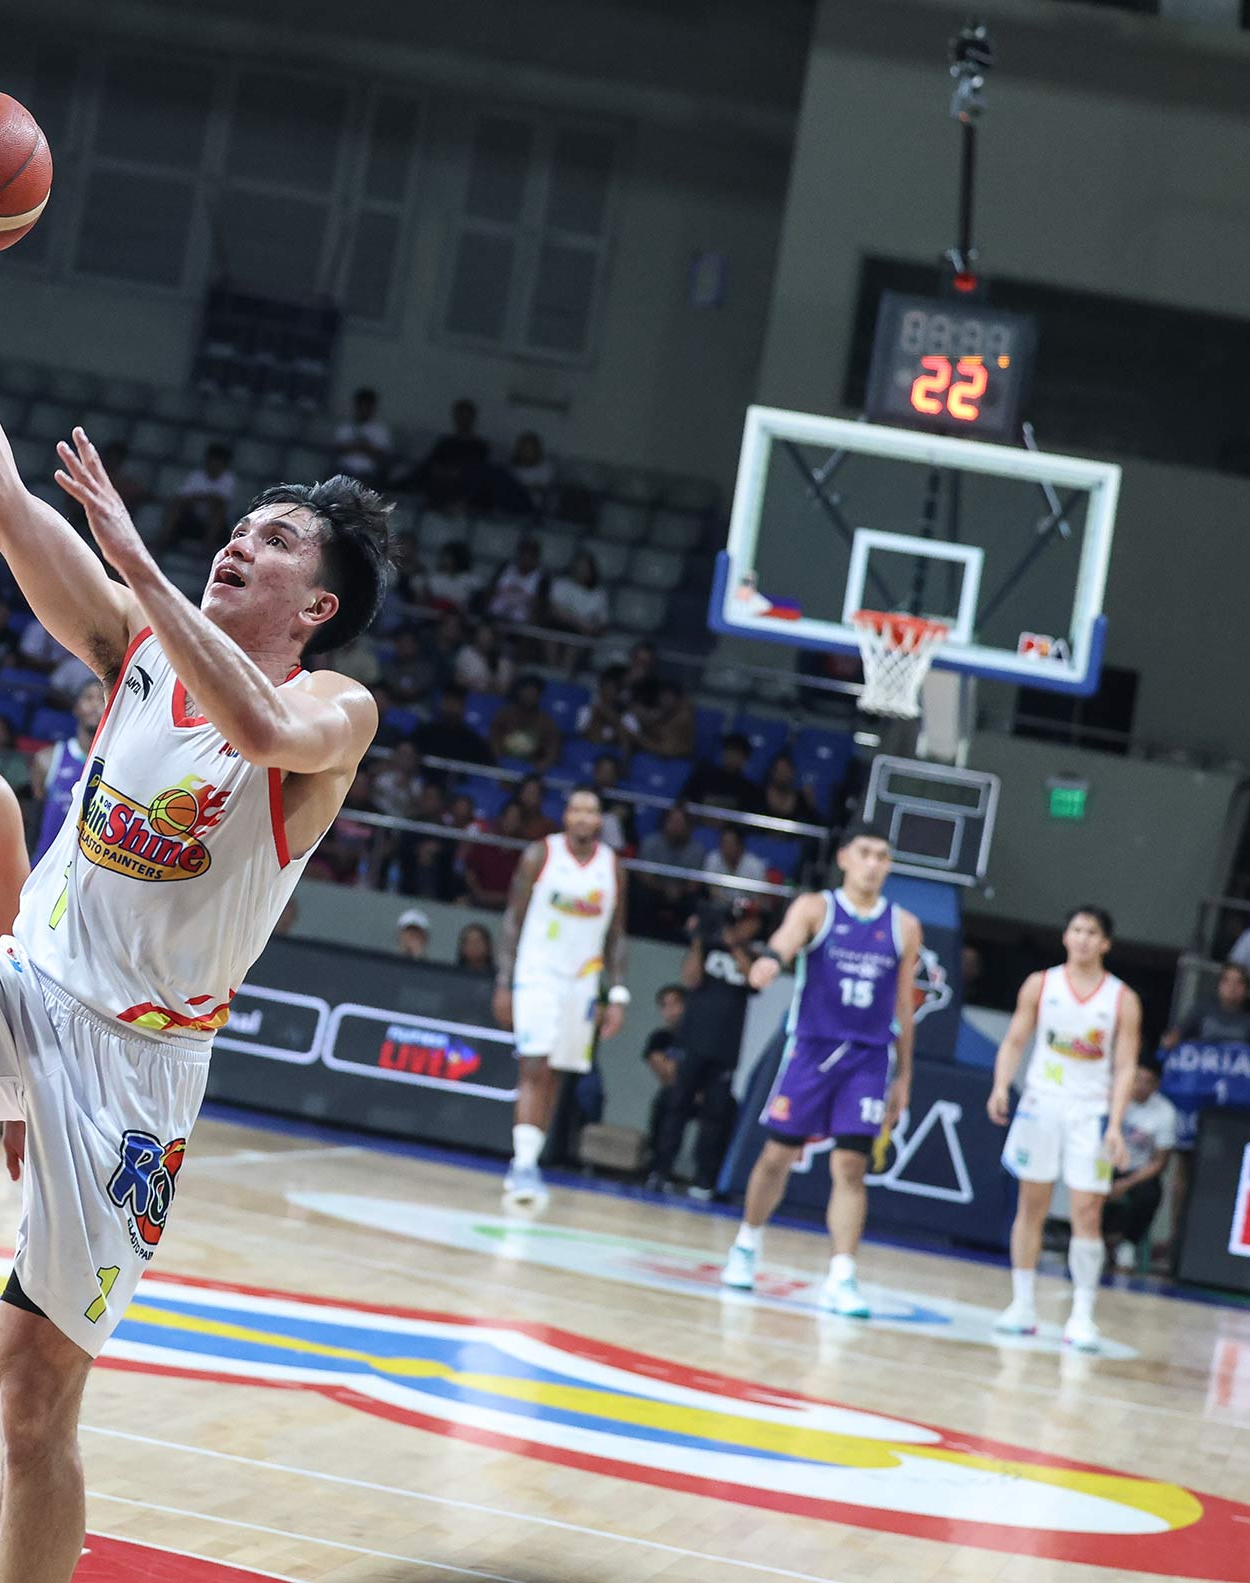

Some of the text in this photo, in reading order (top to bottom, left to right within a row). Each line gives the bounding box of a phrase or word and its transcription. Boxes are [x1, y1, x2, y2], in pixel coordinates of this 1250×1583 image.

[910, 353, 989, 422] 22
[100, 803, 206, 874] Shine
[102, 848, 164, 880] PAINTERS
[84, 1265, 121, 1324] 1
